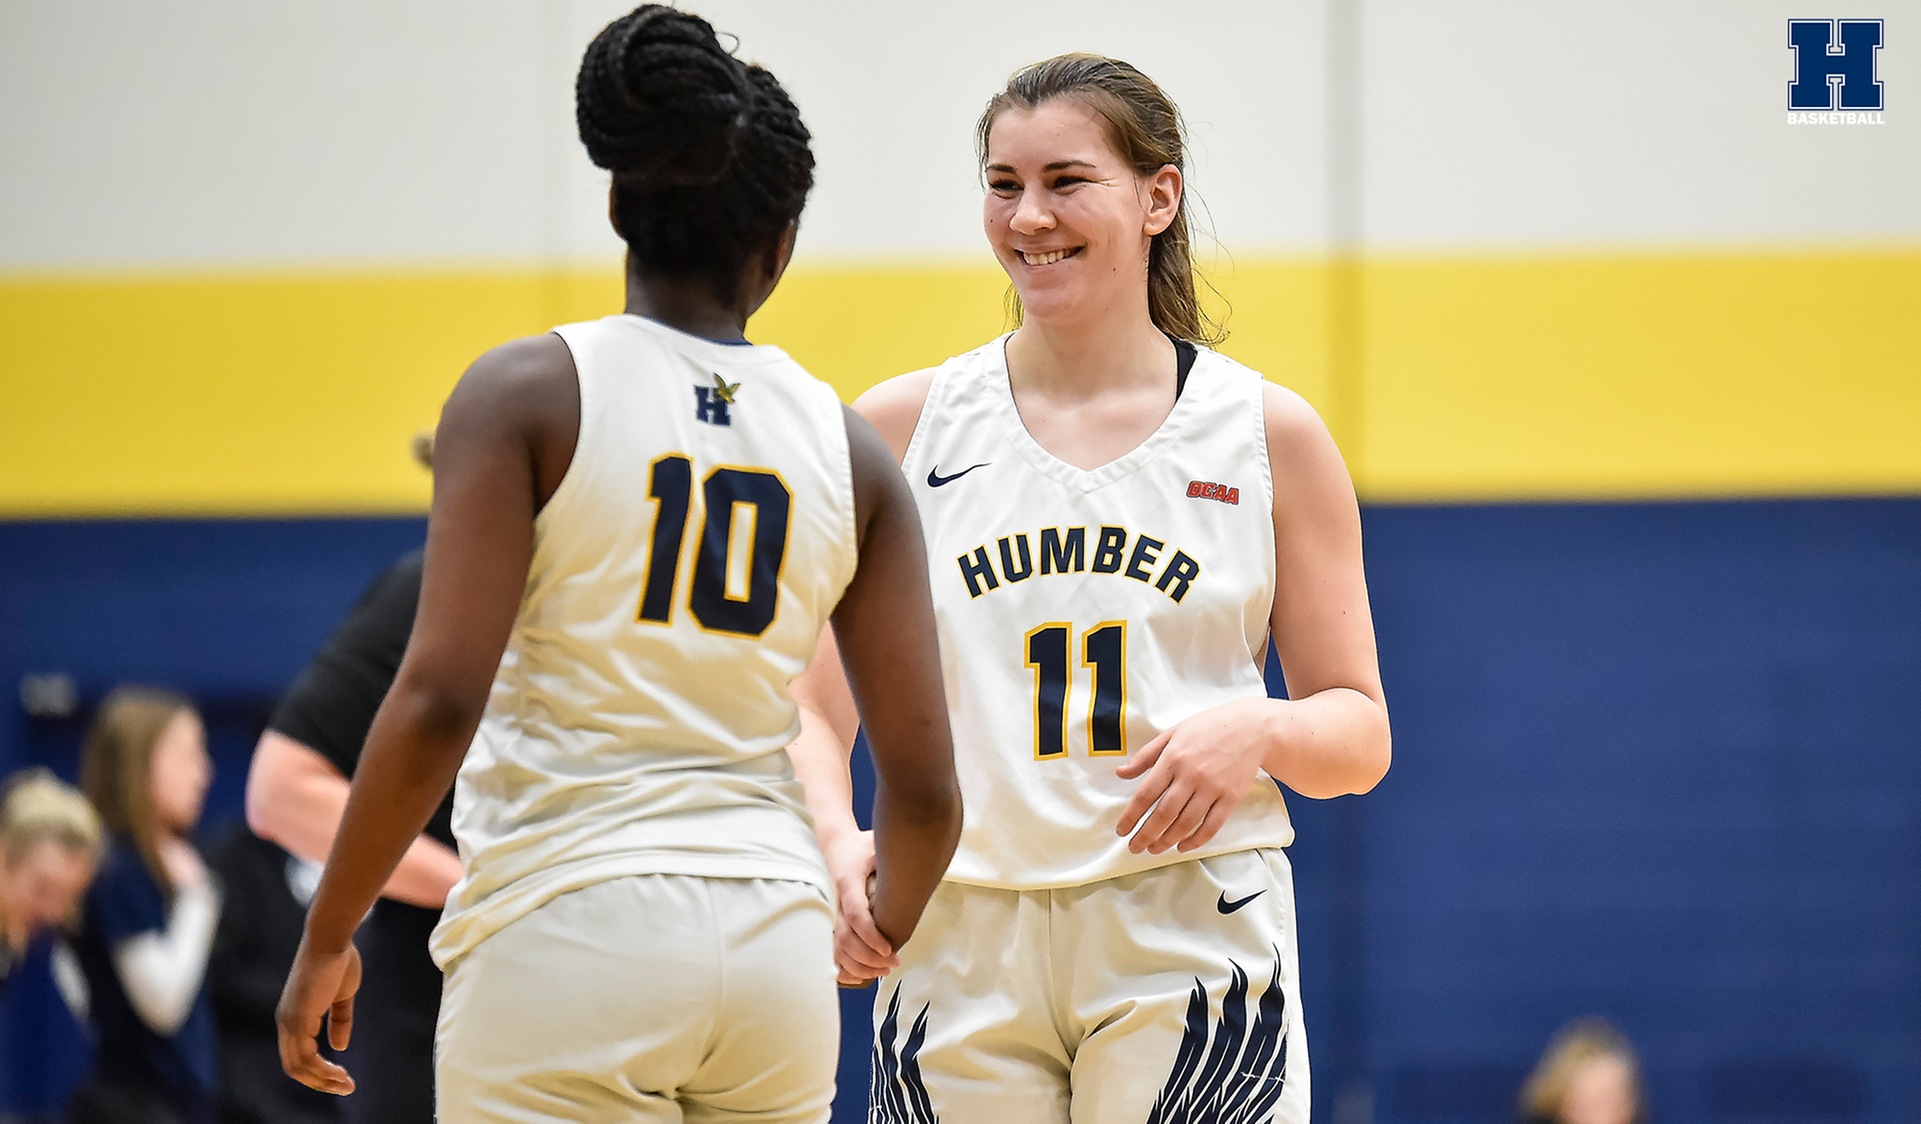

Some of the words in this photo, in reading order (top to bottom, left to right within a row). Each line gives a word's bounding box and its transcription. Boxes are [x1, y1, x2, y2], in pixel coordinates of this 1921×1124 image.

[634, 452, 795, 641] 10
[1186, 480, 1240, 505] OCAA
[956, 524, 1201, 606] HUMBER
[1024, 619, 1128, 761] 11
